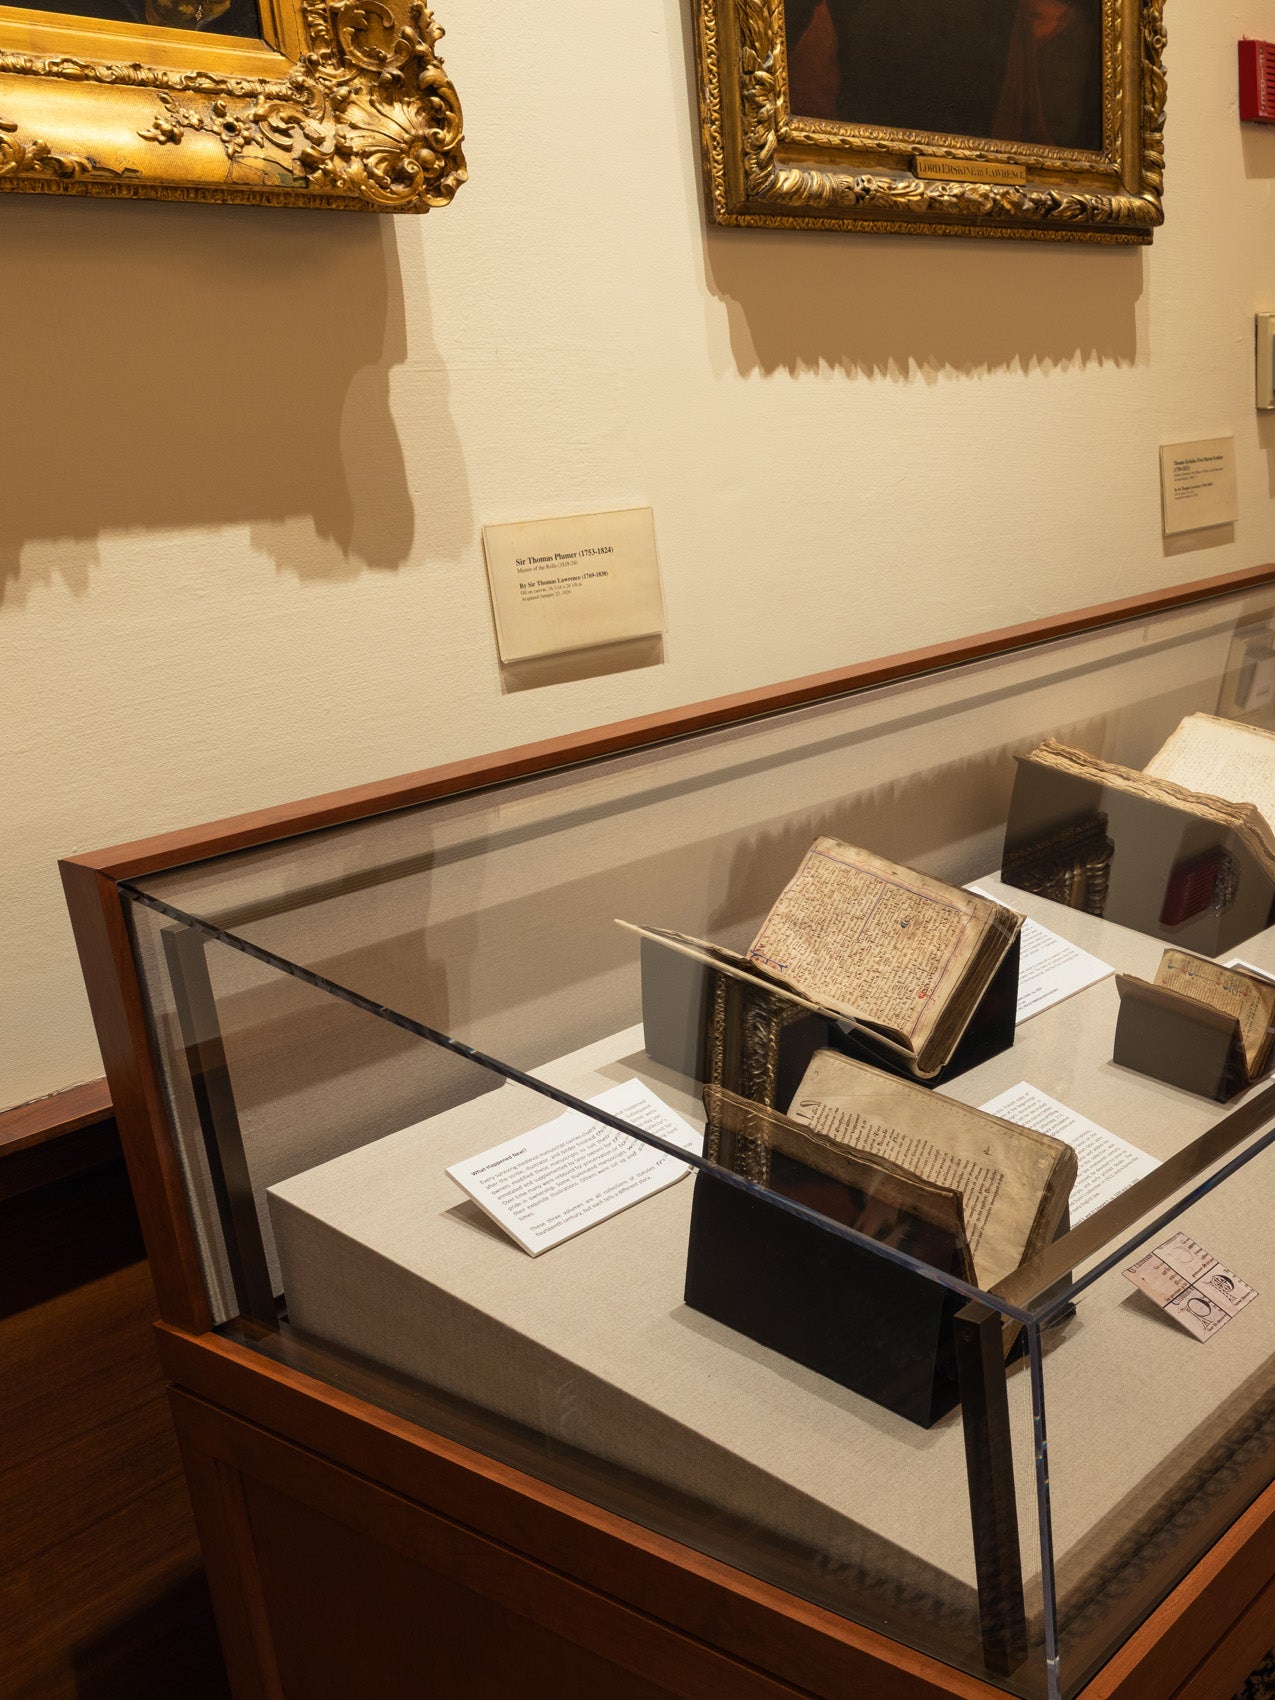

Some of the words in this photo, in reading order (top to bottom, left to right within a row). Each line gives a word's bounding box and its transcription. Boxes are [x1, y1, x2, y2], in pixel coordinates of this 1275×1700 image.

[527, 556, 553, 564] Thomas
[554, 553, 578, 561] Plumer
[578, 546, 614, 558] (1753-1824)
[581, 570, 609, 581] (1769-1830)
[471, 1167, 487, 1176] What
[485, 1155, 513, 1170] Happened
[511, 1148, 528, 1157] Next?
[479, 1176, 496, 1185] Every
[495, 1166, 518, 1178] surviving
[517, 1154, 540, 1168] medieval
[539, 1142, 567, 1157] manuscript
[565, 1135, 583, 1145] carries
[485, 1182, 500, 1190] after
[508, 1170, 524, 1179] scribe,
[524, 1158, 549, 1171] illustrator,
[559, 1145, 577, 1154] binder
[575, 1134, 596, 1146] finished
[491, 1184, 510, 1195] owners
[511, 1172, 534, 1185] modified
[533, 1166, 549, 1174] these
[549, 1151, 579, 1167] manuscripts
[496, 1185, 523, 1200] annotated
[533, 1163, 569, 1183] supplemented
[586, 1147, 604, 1156] owners
[501, 1198, 516, 1206] Over
[527, 1185, 543, 1193] many
[554, 1168, 576, 1180] rebound
[583, 1150, 613, 1166] preservation
[507, 1202, 522, 1211] pride
[555, 1178, 571, 1187] Some
[570, 1164, 598, 1180] illuminated
[598, 1150, 627, 1166] manuscripts
[512, 1208, 527, 1216] their
[527, 1197, 549, 1209] exquisite
[579, 1173, 597, 1183] Others
[529, 1222, 546, 1231] These
[545, 1214, 562, 1223] three
[562, 1203, 584, 1215] volumes
[602, 1180, 629, 1194] collections
[636, 1166, 656, 1177] statutes
[535, 1221, 563, 1237] fourteenth
[562, 1211, 583, 1223] century,
[592, 1200, 604, 1208] each
[617, 1182, 639, 1195] different
